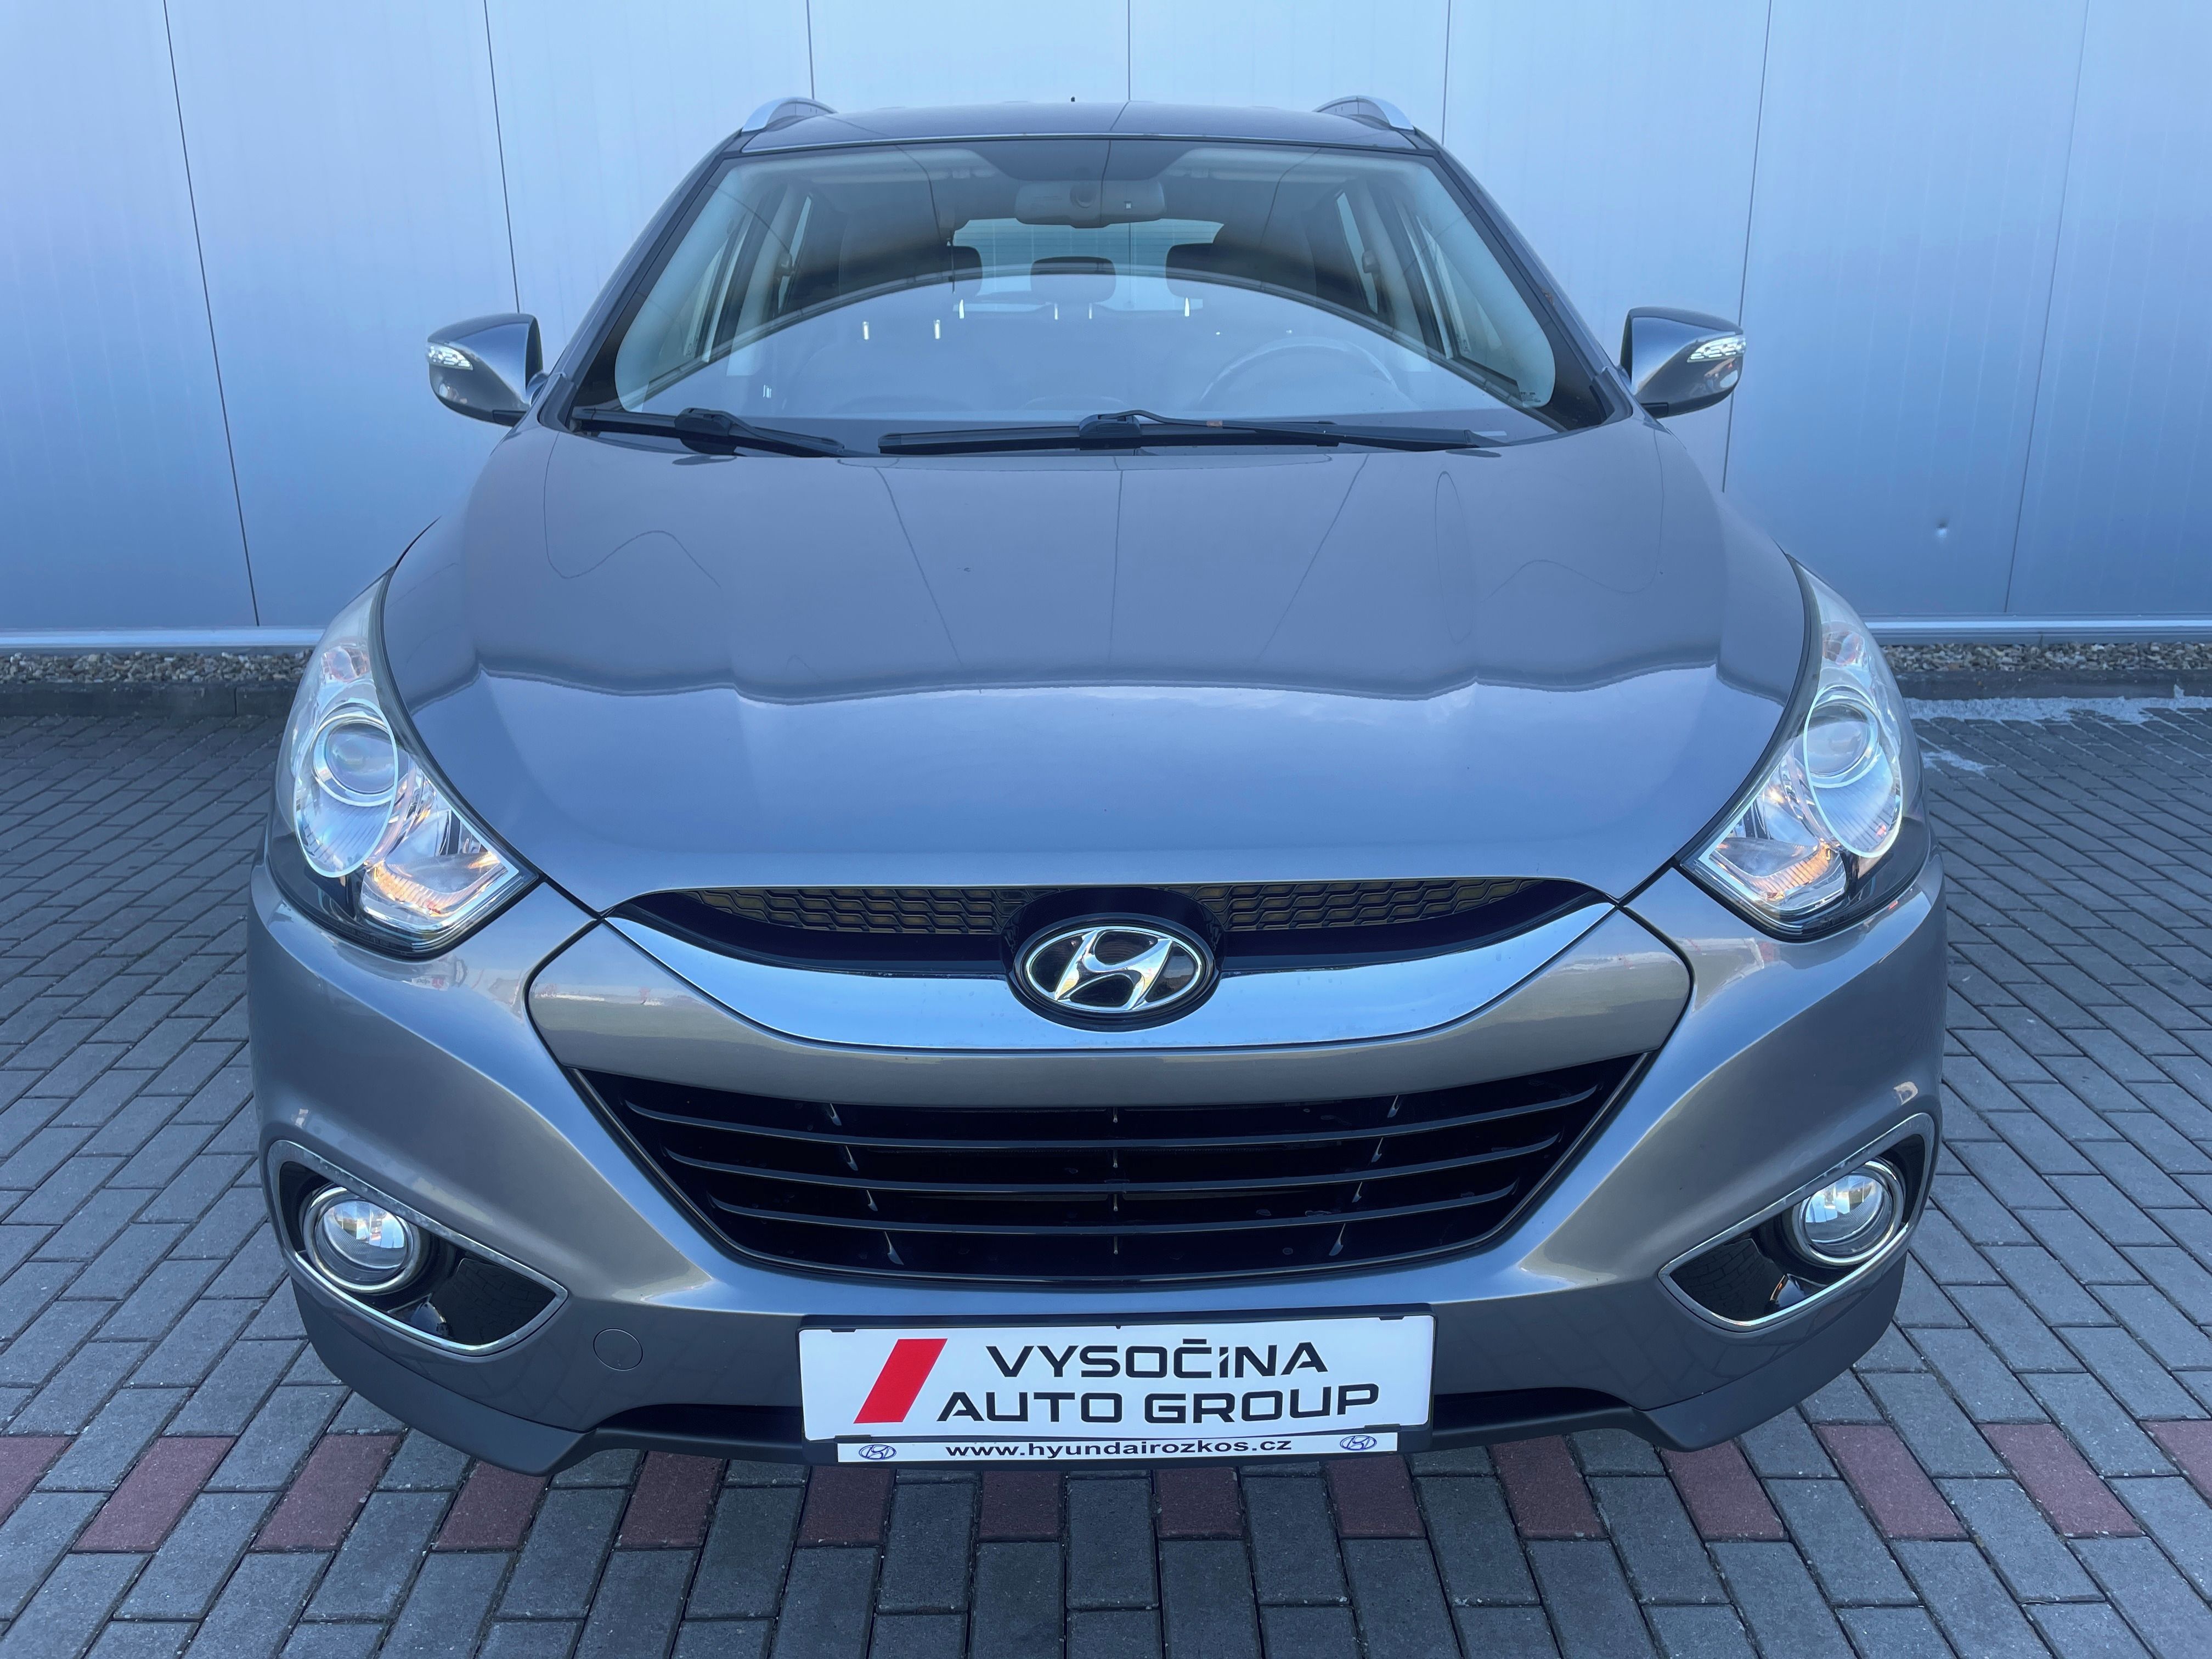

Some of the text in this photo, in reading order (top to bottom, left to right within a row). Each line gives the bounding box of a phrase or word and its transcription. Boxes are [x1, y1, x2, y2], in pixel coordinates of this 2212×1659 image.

[936, 1383, 1380, 1424] AUTO GROUP
[945, 1440, 1292, 1459] www.hyundairozkos.cz
